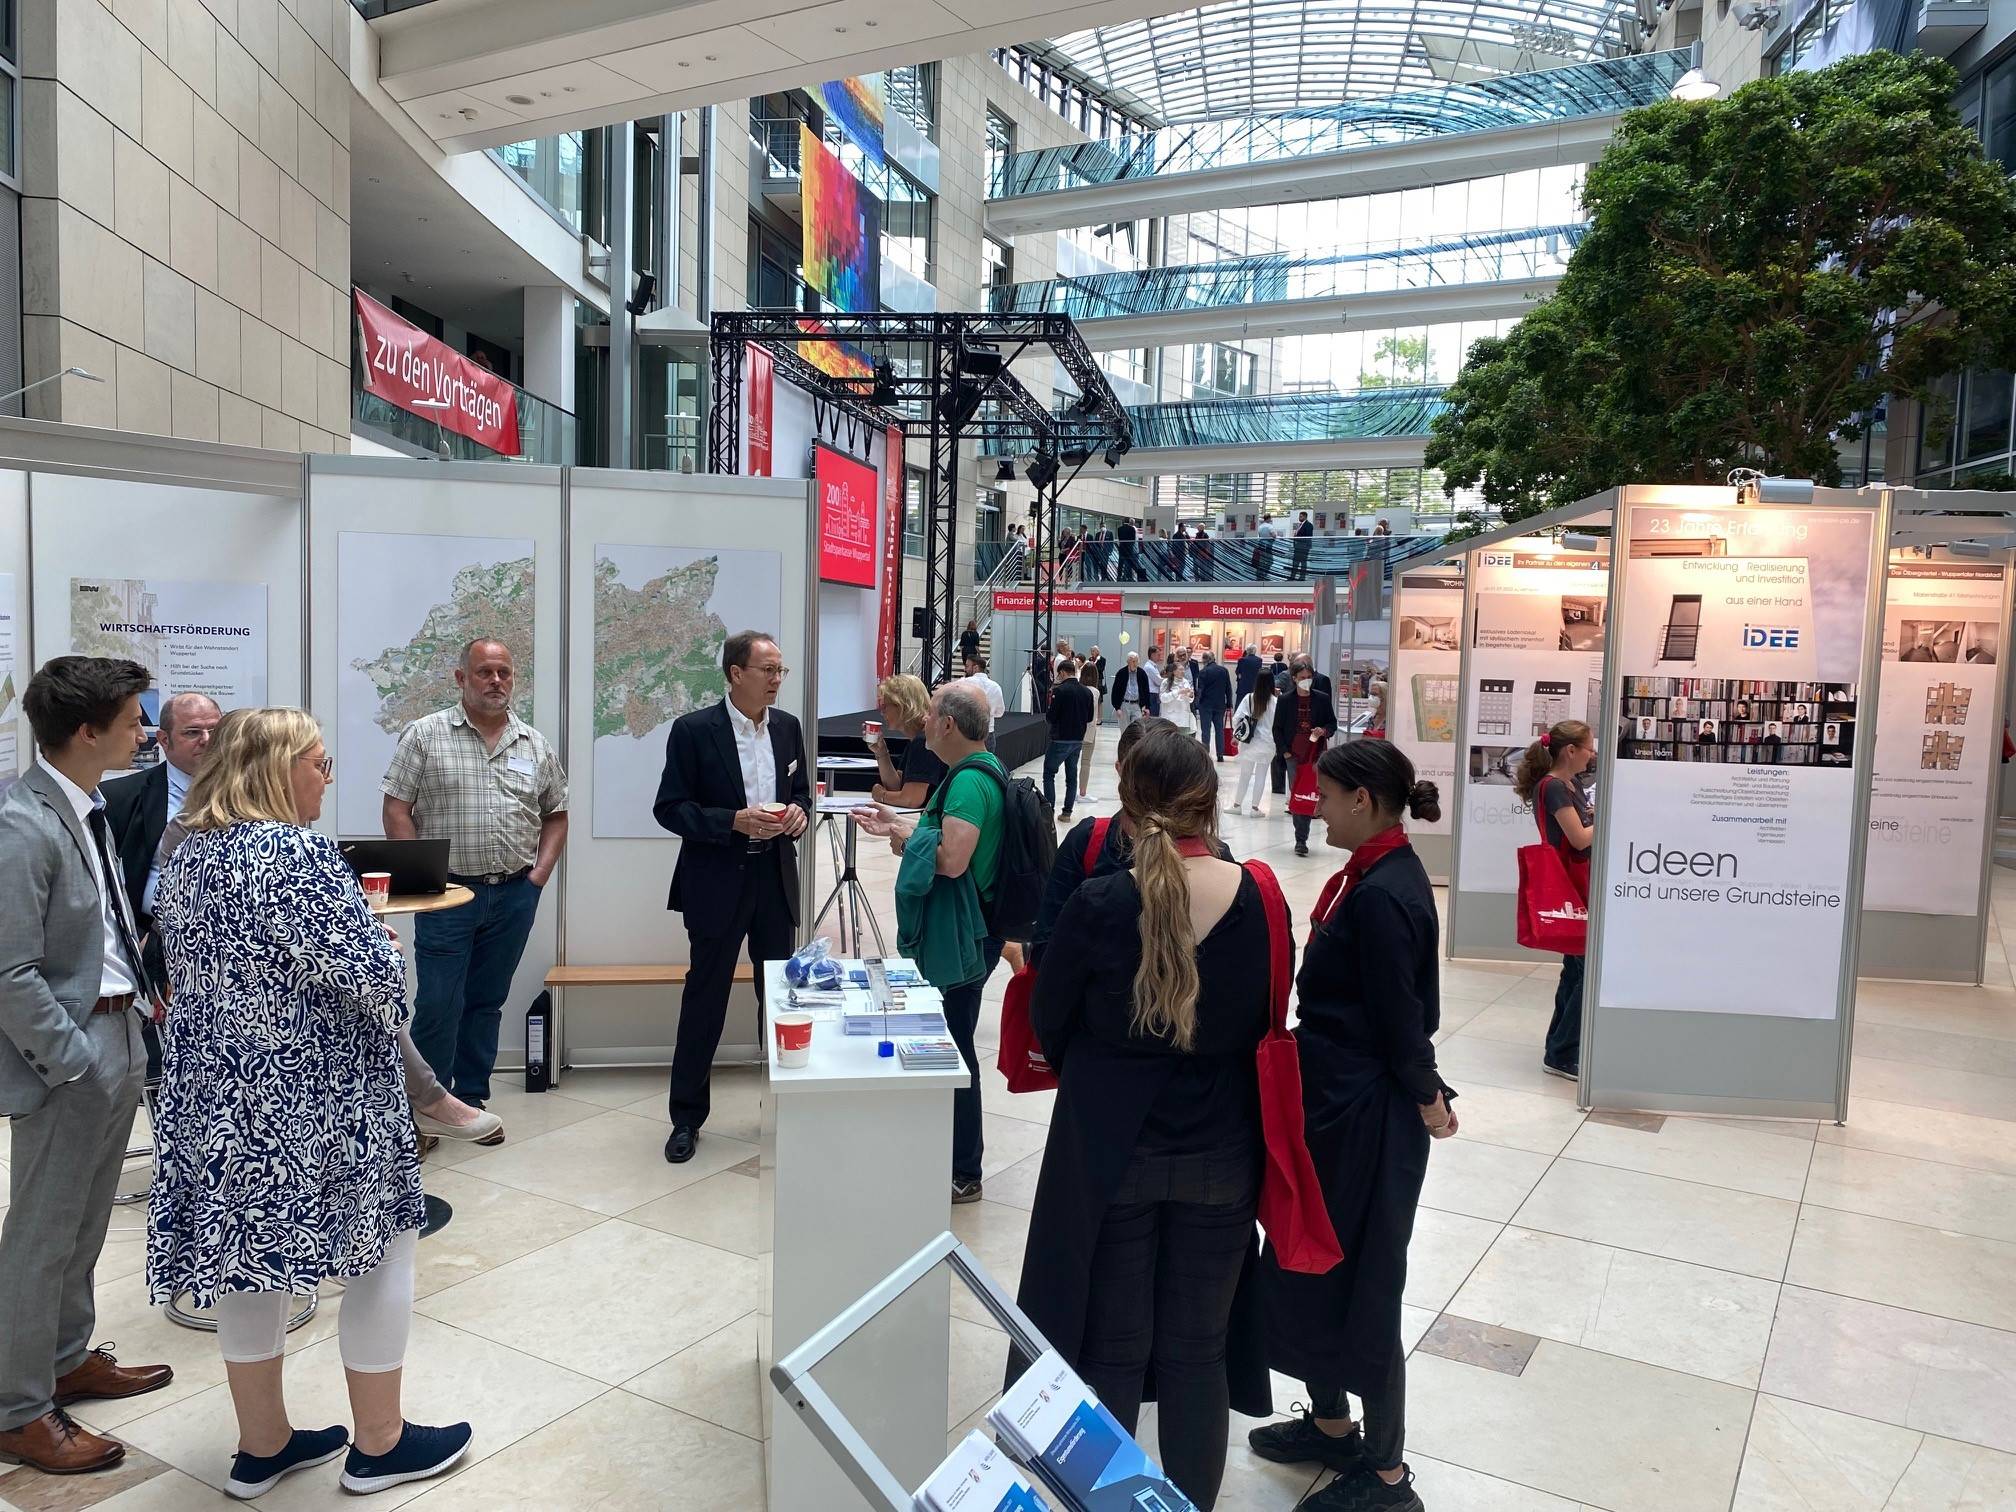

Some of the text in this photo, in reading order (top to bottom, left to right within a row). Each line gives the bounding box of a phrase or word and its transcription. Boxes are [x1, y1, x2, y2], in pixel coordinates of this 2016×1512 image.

[402, 340, 430, 394] den
[433, 357, 502, 431] Vorträgen
[826, 482, 840, 506] 200
[1650, 518, 1670, 533] 23
[1683, 561, 1739, 573] Entwicklung
[1747, 562, 1805, 575] Realisierung
[1736, 575, 1805, 584] und Investition
[1725, 596, 1803, 607] aus einer Hand
[1212, 604, 1309, 616] Bauen und Wohnen
[99, 623, 251, 637] WIRTSCHAFTSFÖRDERUNG
[1635, 748, 1673, 757] Unser Team
[1711, 814, 1774, 824] Zusammenarbeit
[1627, 841, 1738, 878] Ideen
[1614, 881, 1651, 899] sind
[1657, 887, 1720, 902] unsere
[1726, 886, 1841, 908] Grundsteine
